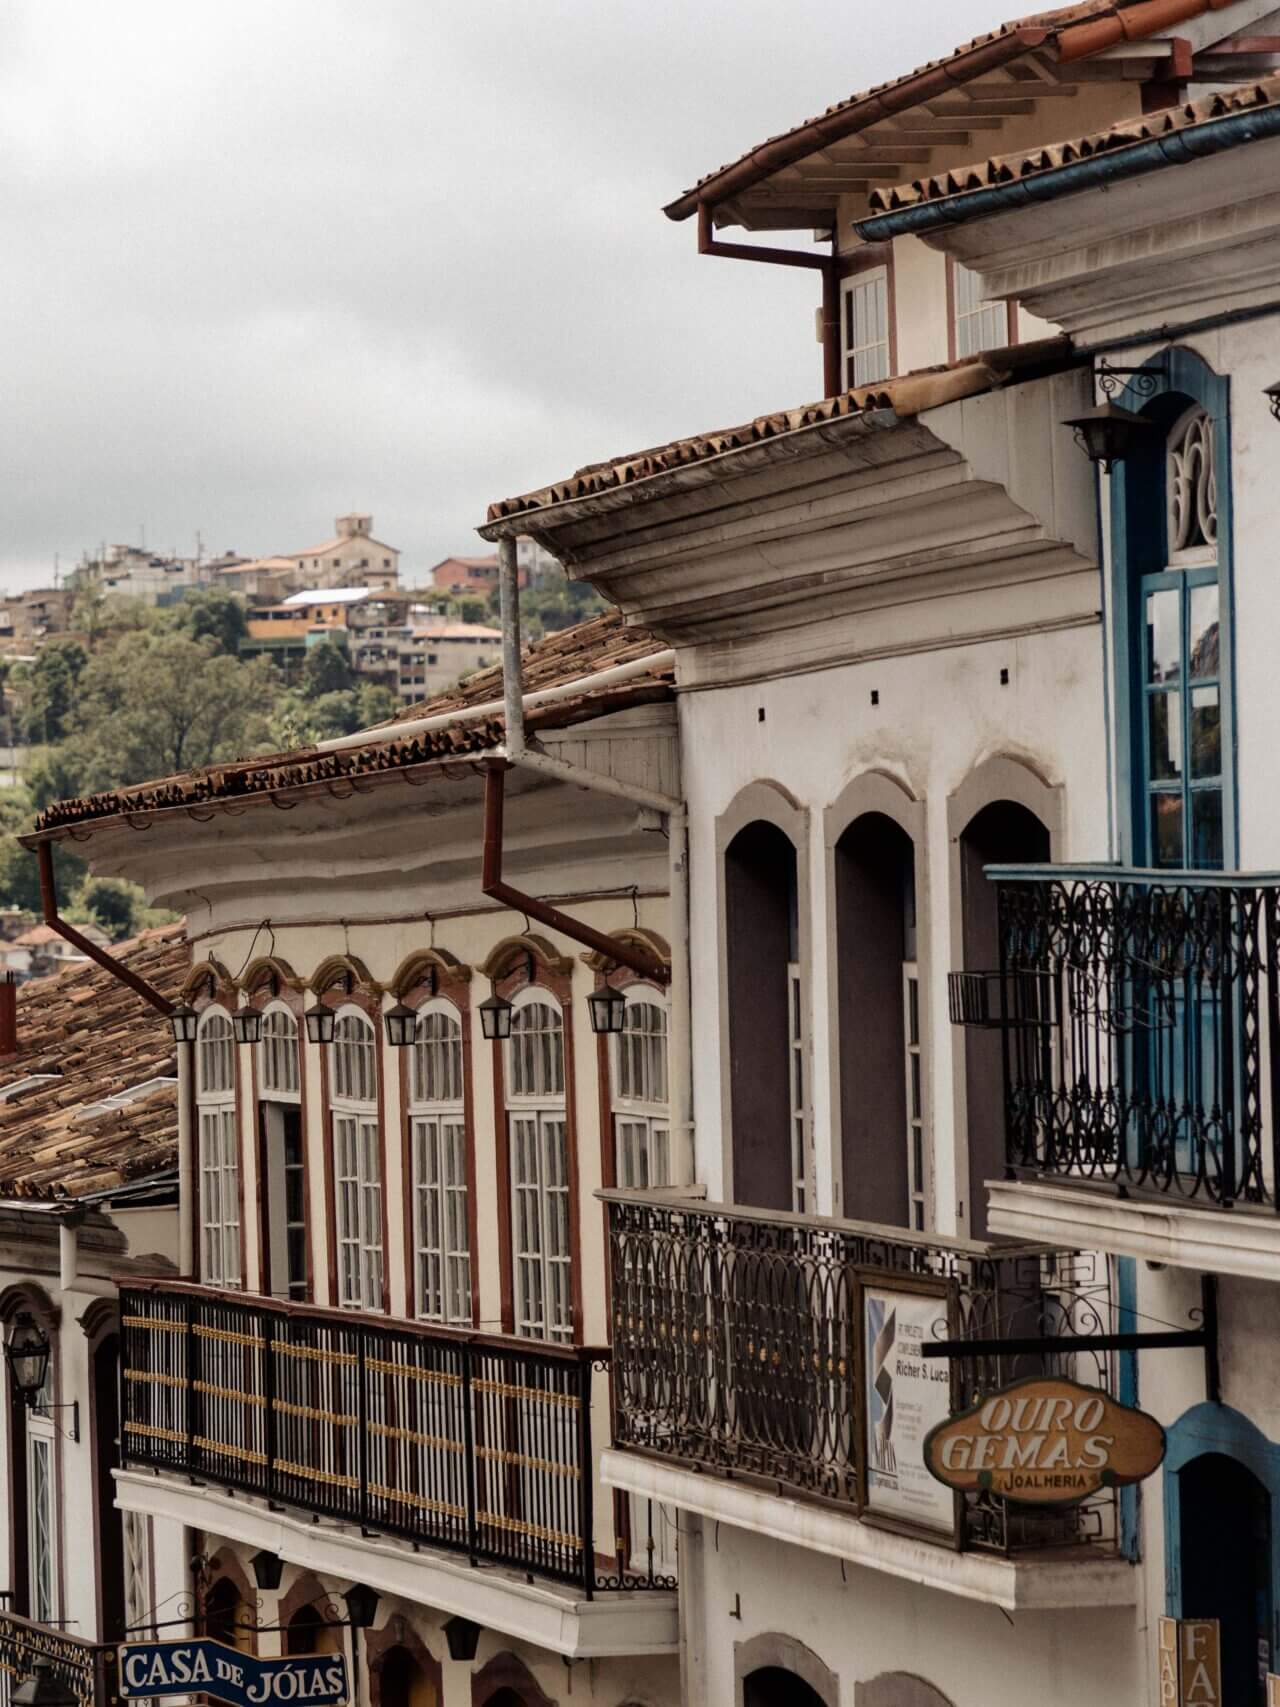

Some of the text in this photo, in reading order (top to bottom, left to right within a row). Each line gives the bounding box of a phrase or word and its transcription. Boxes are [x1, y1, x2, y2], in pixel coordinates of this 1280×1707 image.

[980, 1397, 1105, 1433] OURO
[941, 1434, 1114, 1470] GEMAS
[1004, 1471, 1087, 1491] JOALHERIA
[125, 1648, 344, 1703] CASA DE JÓIAS
